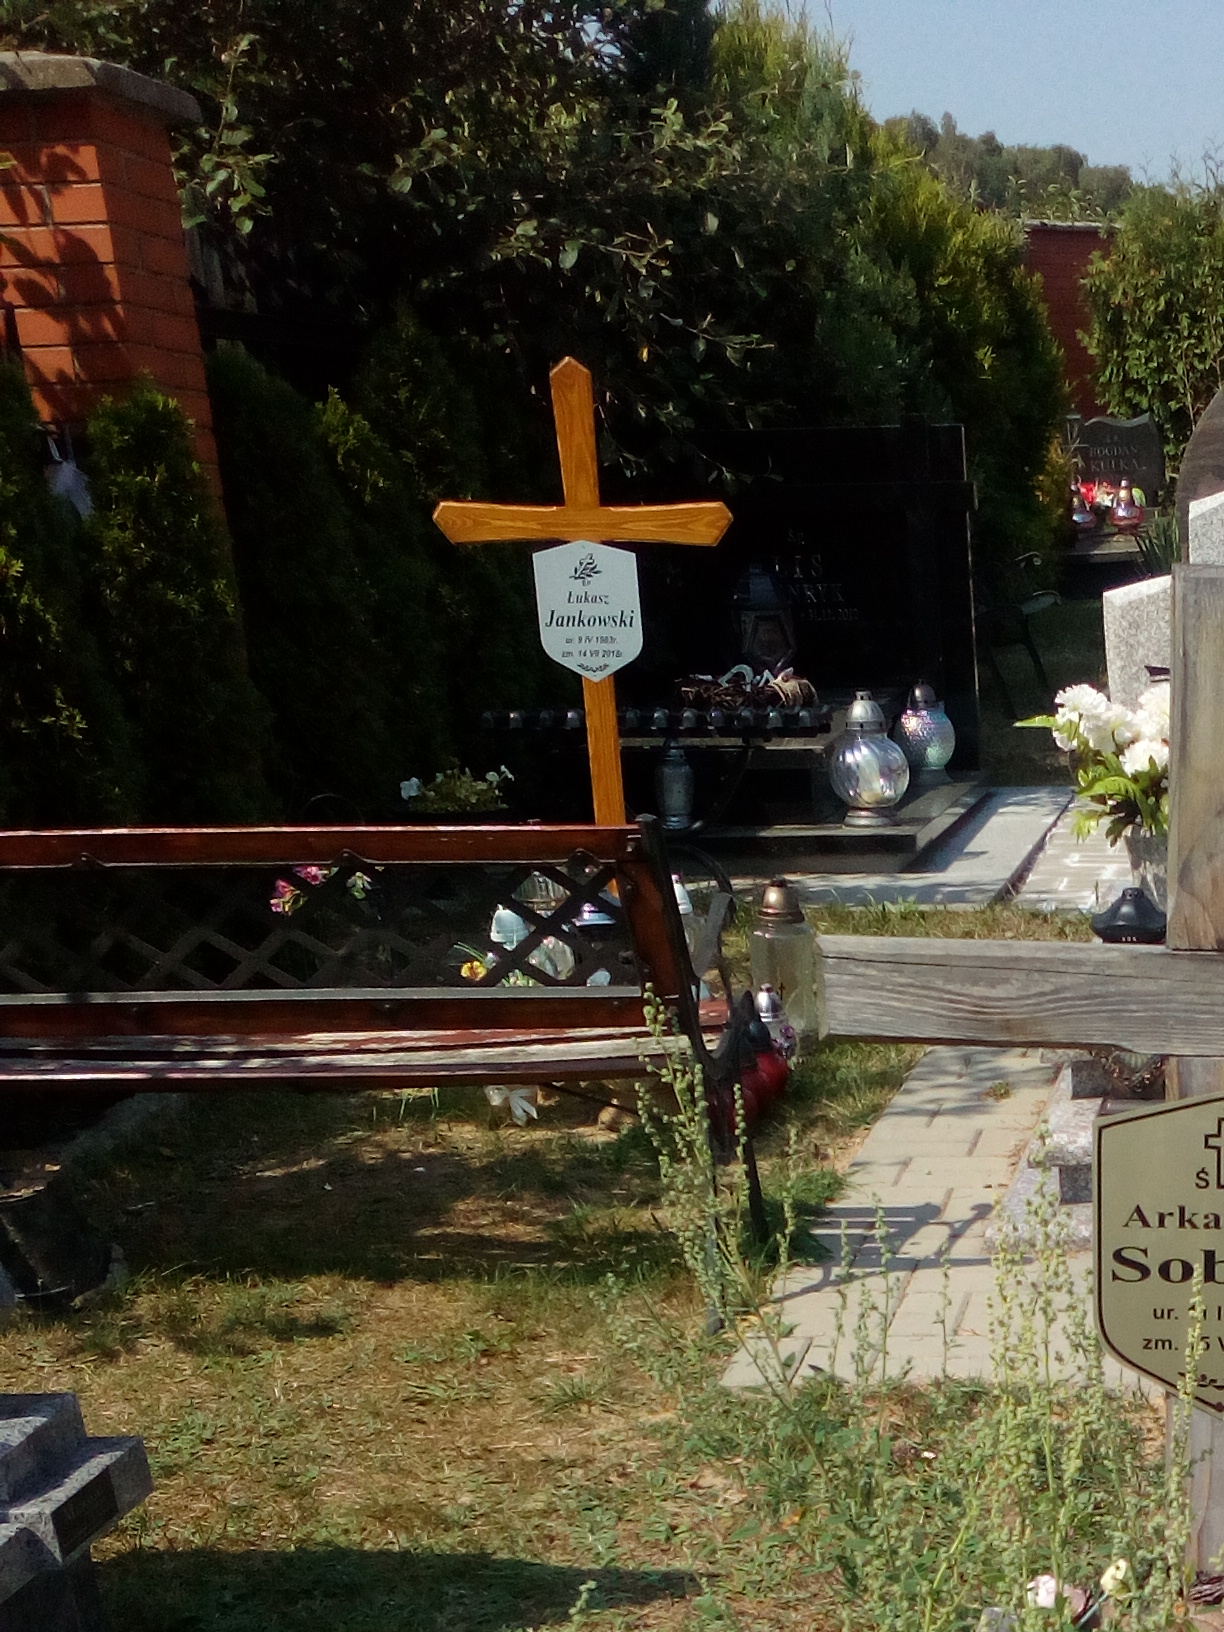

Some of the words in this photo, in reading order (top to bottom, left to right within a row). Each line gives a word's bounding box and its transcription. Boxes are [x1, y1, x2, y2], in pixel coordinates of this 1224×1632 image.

[567, 591, 609, 605] Łukasz
[545, 609, 635, 628] Jankowski
[1153, 1307, 1180, 1320] ur.
[1142, 1337, 1179, 1351] zm.
